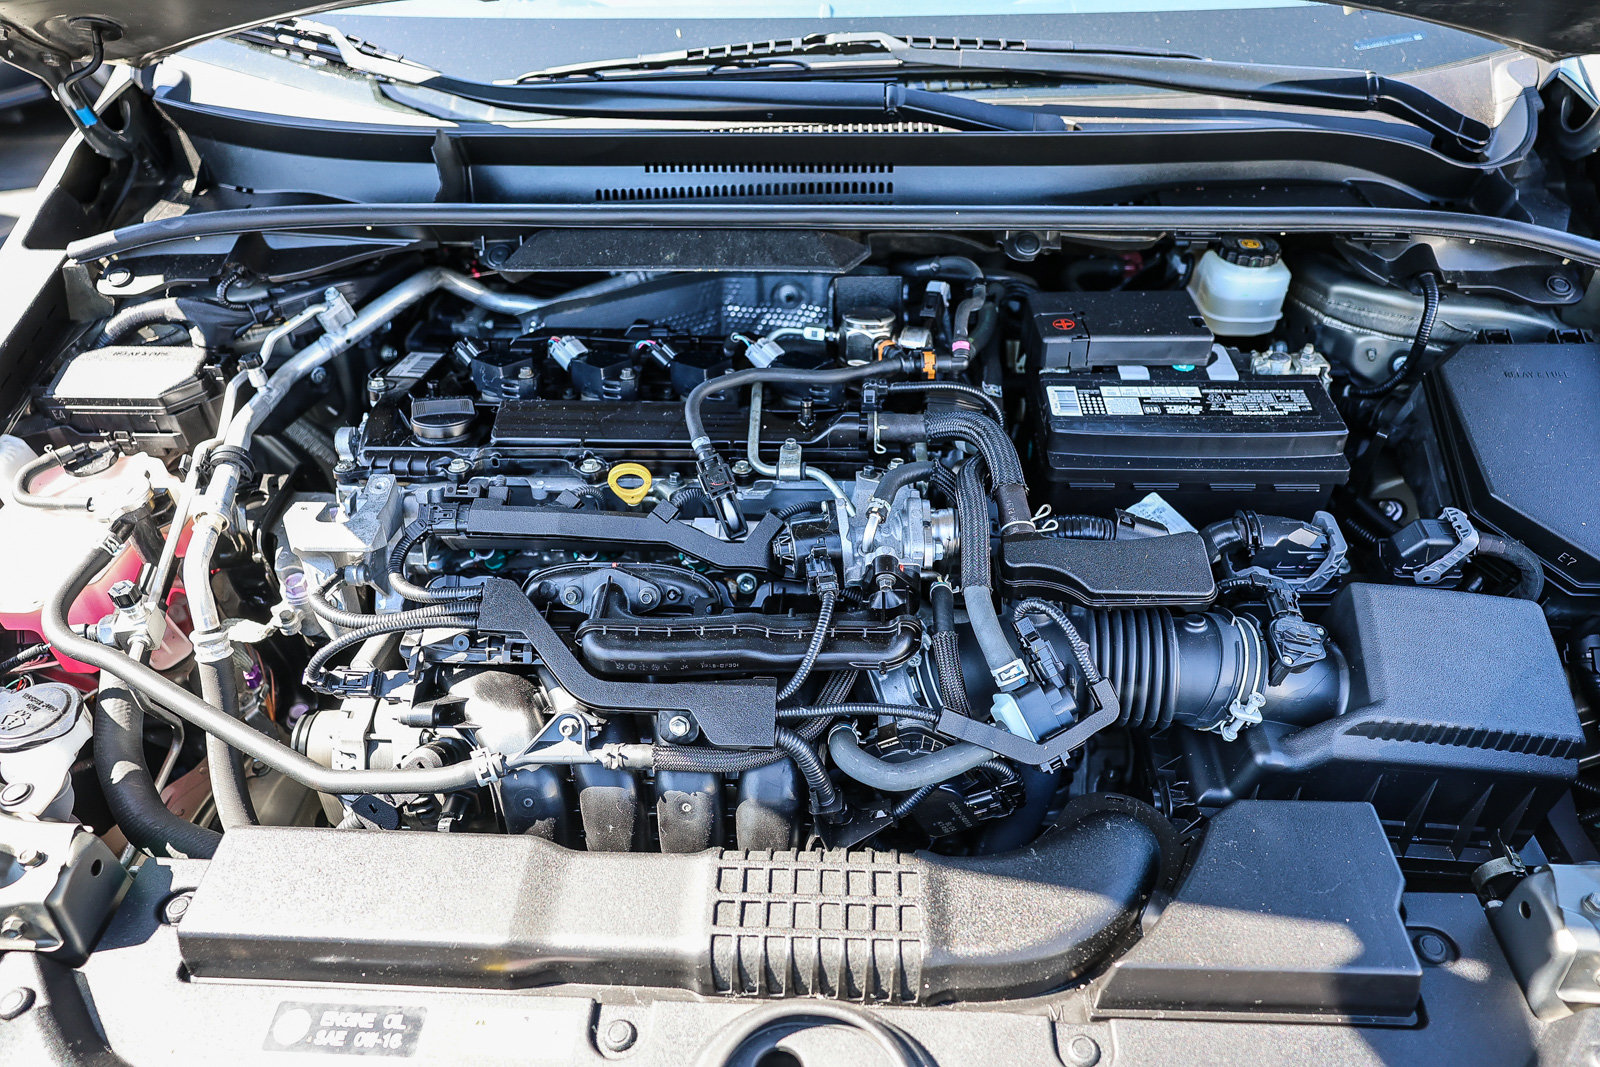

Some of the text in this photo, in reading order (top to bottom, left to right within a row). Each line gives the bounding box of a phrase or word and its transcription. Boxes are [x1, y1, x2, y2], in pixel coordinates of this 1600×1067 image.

[1557, 551, 1578, 567] E7
[320, 1011, 406, 1029] ENGINE OIL
[314, 1030, 347, 1046] SAE
